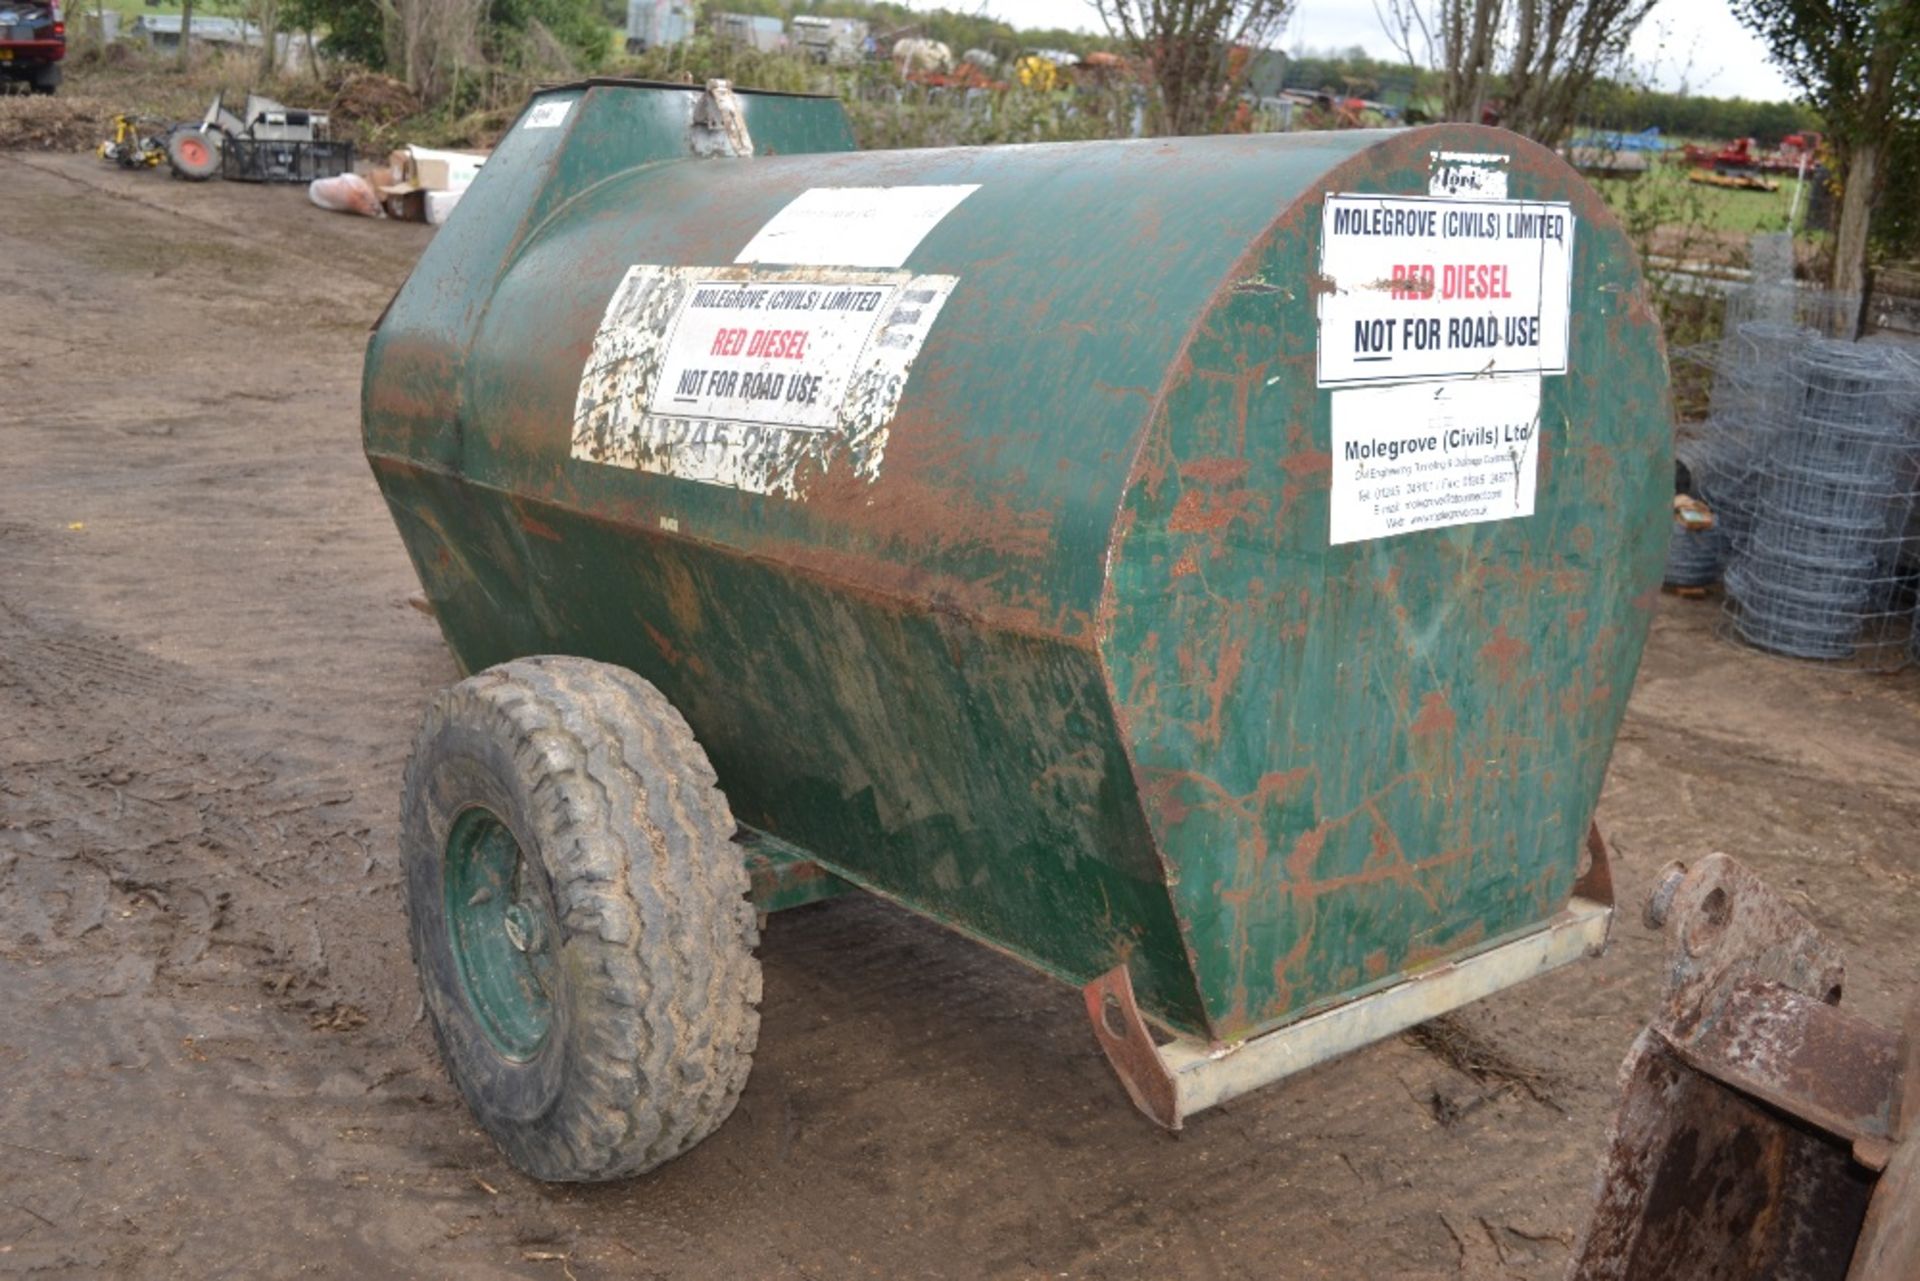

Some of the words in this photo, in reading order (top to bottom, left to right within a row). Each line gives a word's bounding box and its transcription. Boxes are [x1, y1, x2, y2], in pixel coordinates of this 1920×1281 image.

[1334, 208, 1437, 236] MOLEGROVE
[1442, 211, 1501, 240] (CIVILS)
[1507, 212, 1564, 241] LIMITED
[1391, 265, 1435, 300] RED
[1442, 265, 1512, 299] DIESEL
[691, 289, 769, 309] MOLEGROVE
[765, 289, 820, 311] (CIVILS)
[820, 291, 882, 312] LIMITED
[710, 327, 748, 356] RED
[746, 329, 809, 359] DIESEL
[1354, 319, 1397, 352] NOT
[1403, 318, 1441, 351] FOR
[1448, 316, 1498, 349] ROAD
[1505, 316, 1540, 347] USE
[676, 369, 707, 397] NOT
[706, 370, 738, 397] FOR
[739, 371, 785, 400] ROAD
[786, 372, 823, 404] USE
[1345, 435, 1437, 462] Molegrove
[1443, 425, 1498, 453] (Civils)
[1504, 422, 1530, 442] Ltd
